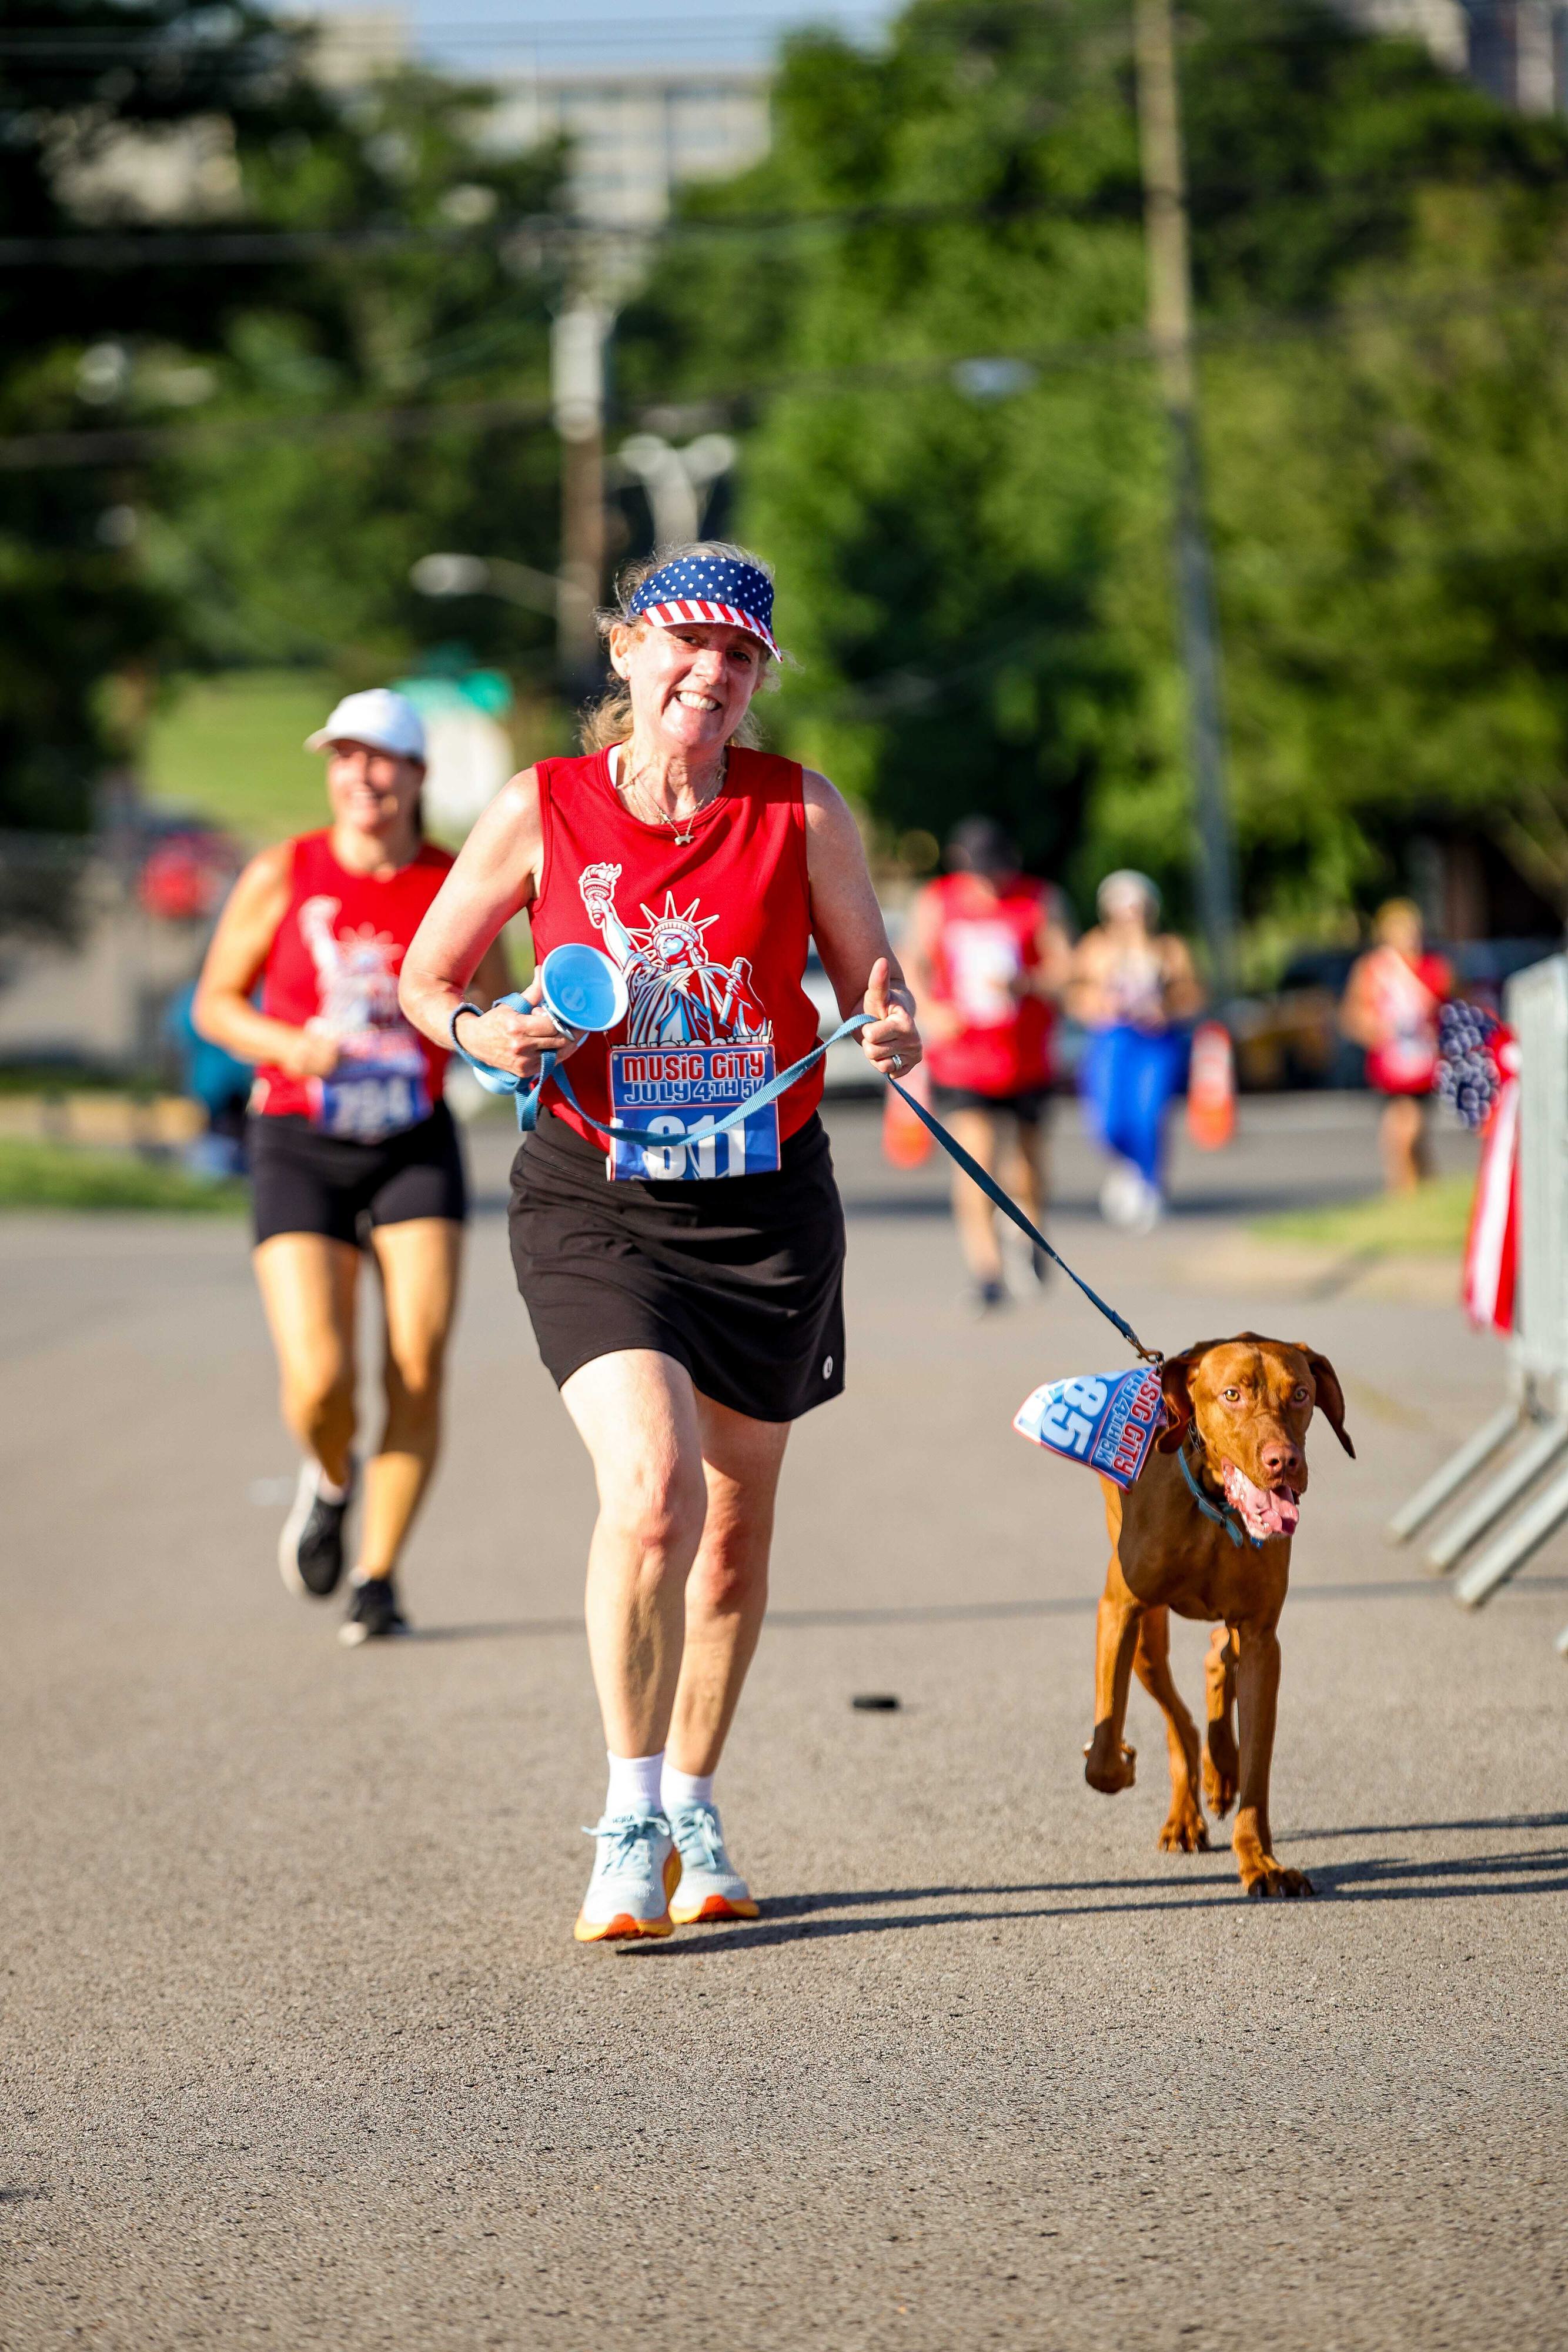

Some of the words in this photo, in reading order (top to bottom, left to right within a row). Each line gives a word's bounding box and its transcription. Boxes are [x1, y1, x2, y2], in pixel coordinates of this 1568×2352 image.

[624, 1081, 691, 1104] JULY
[693, 1079, 738, 1101] 4TH
[1040, 1369, 1126, 1456] 85
[1095, 1437, 1118, 1468] 5K
